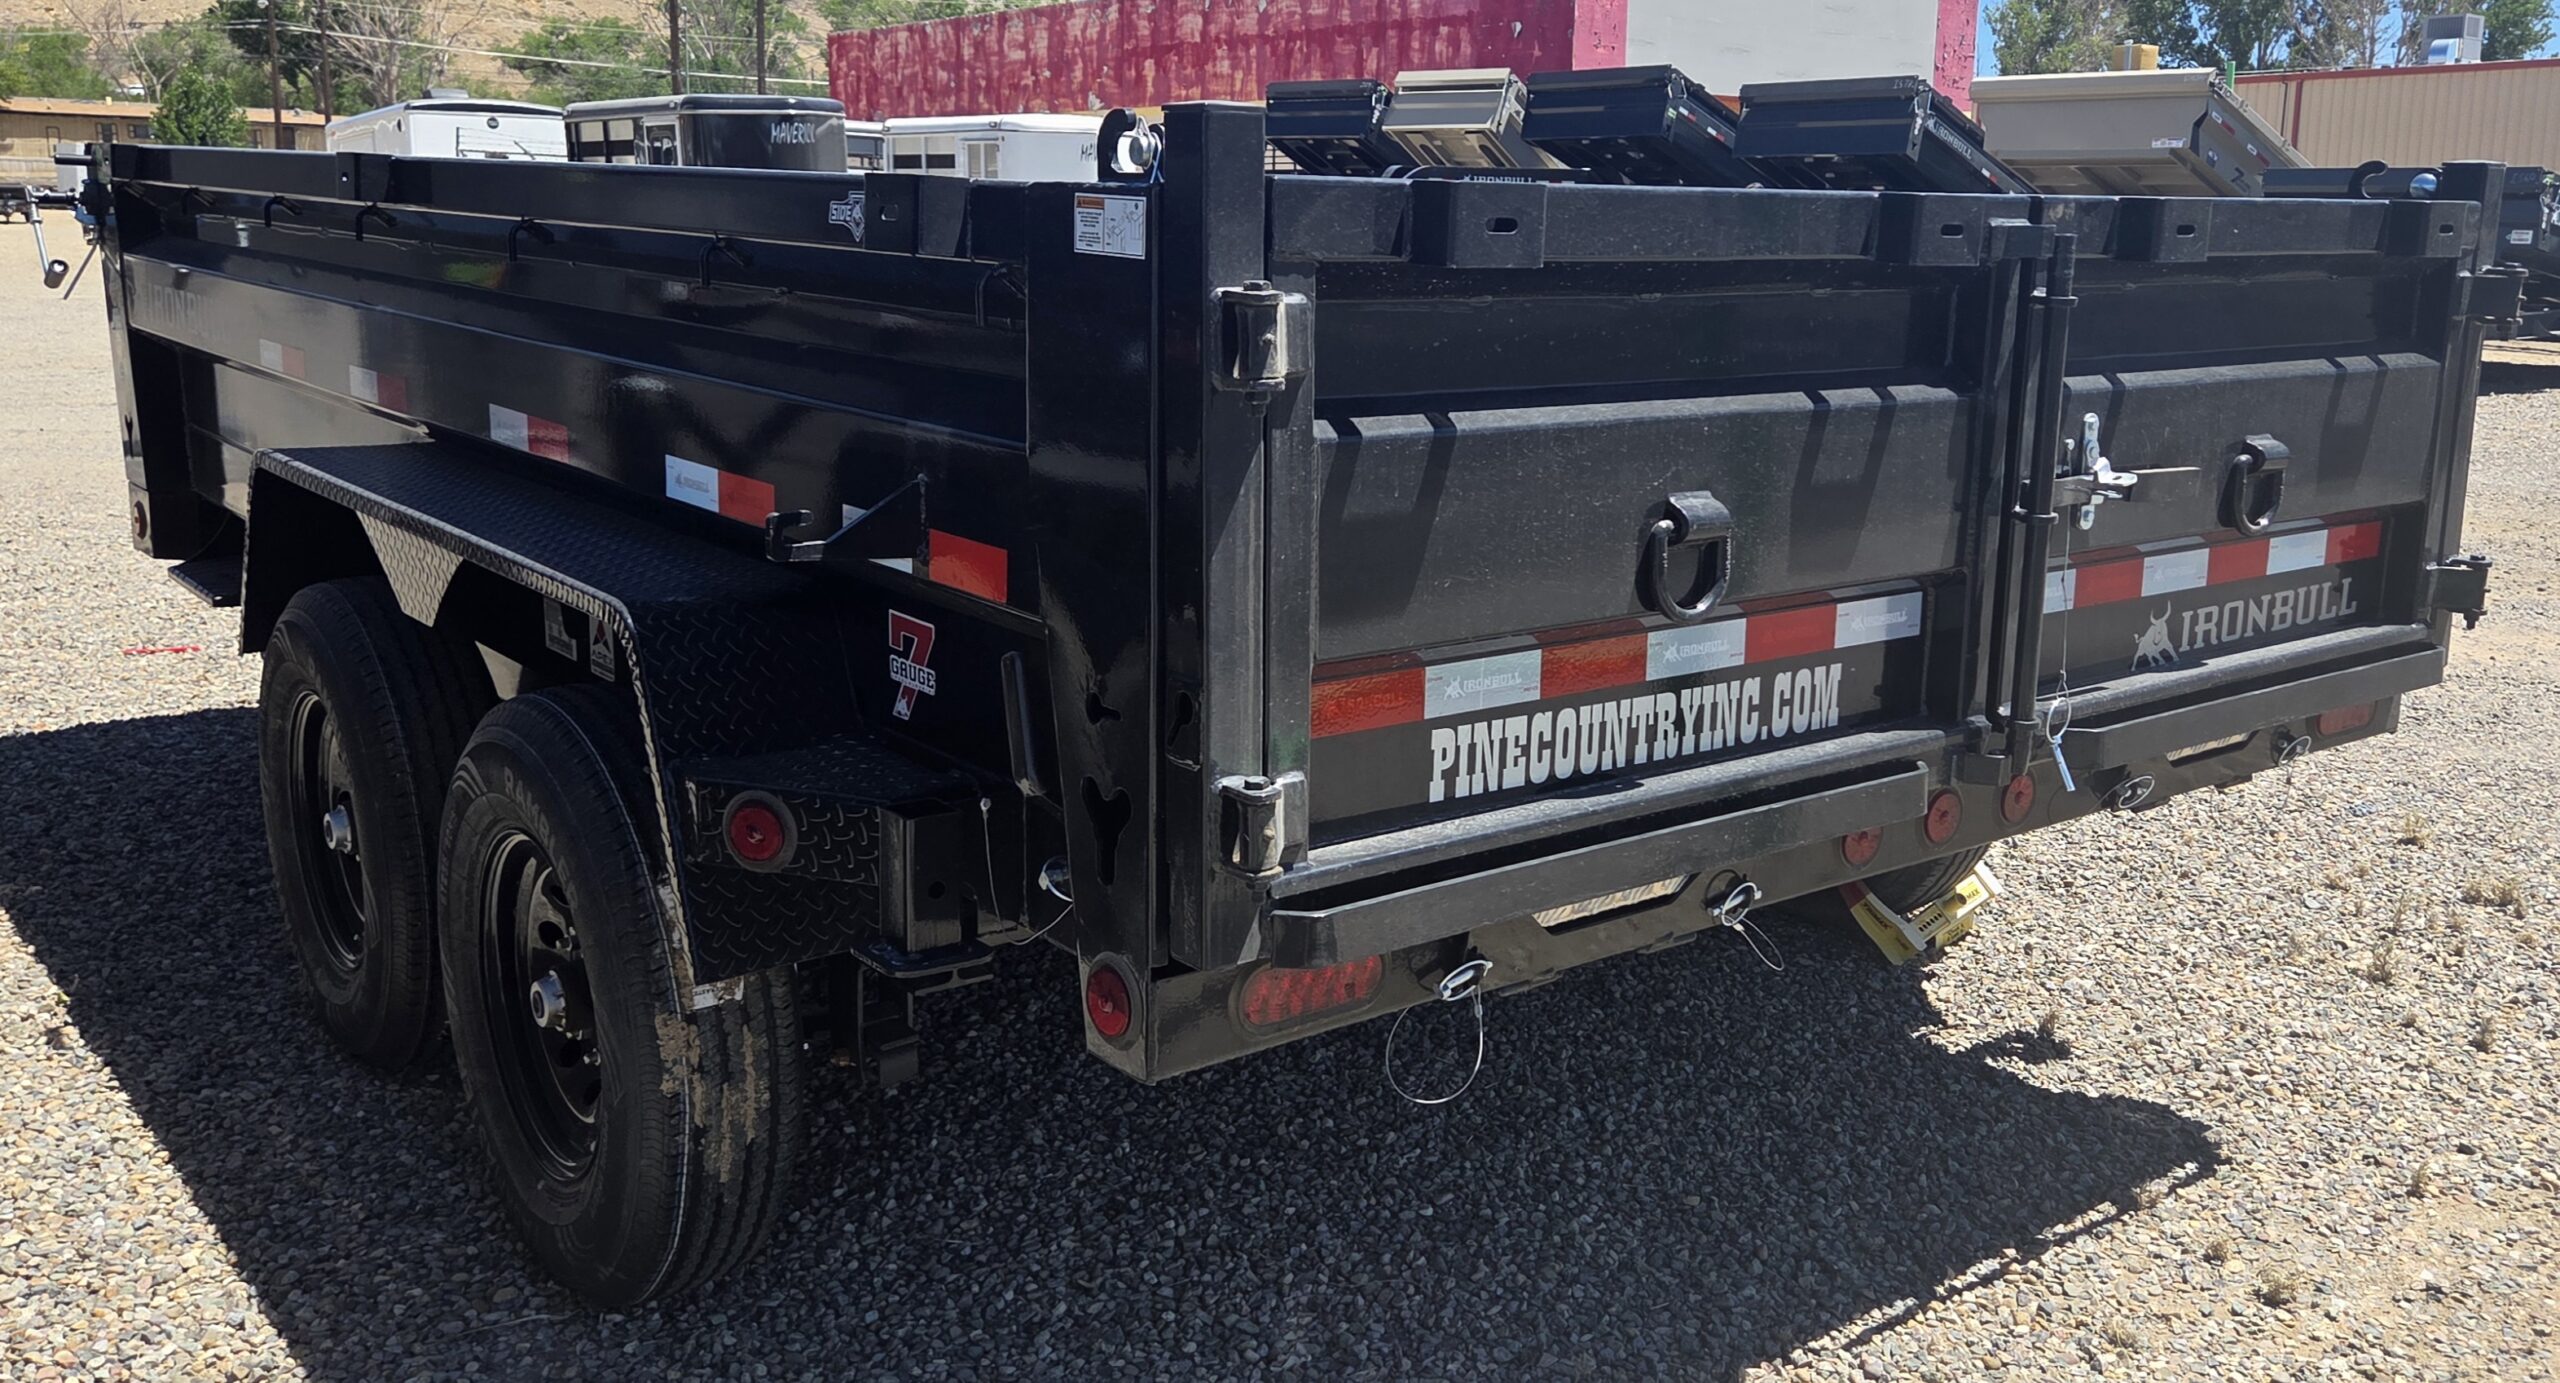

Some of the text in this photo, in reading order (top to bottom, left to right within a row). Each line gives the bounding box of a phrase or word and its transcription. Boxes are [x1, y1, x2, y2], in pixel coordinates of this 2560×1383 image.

[1934, 122, 1972, 160] IRONBULL
[831, 204, 851, 221] SIDE
[2179, 577, 2357, 653] IRONBULL
[1679, 640, 1729, 658] IRONBULL
[890, 656, 936, 691] GAUGE
[1463, 671, 1522, 693] IRONBULL
[1429, 663, 1842, 803] PINECOUNTRYINC.COM
